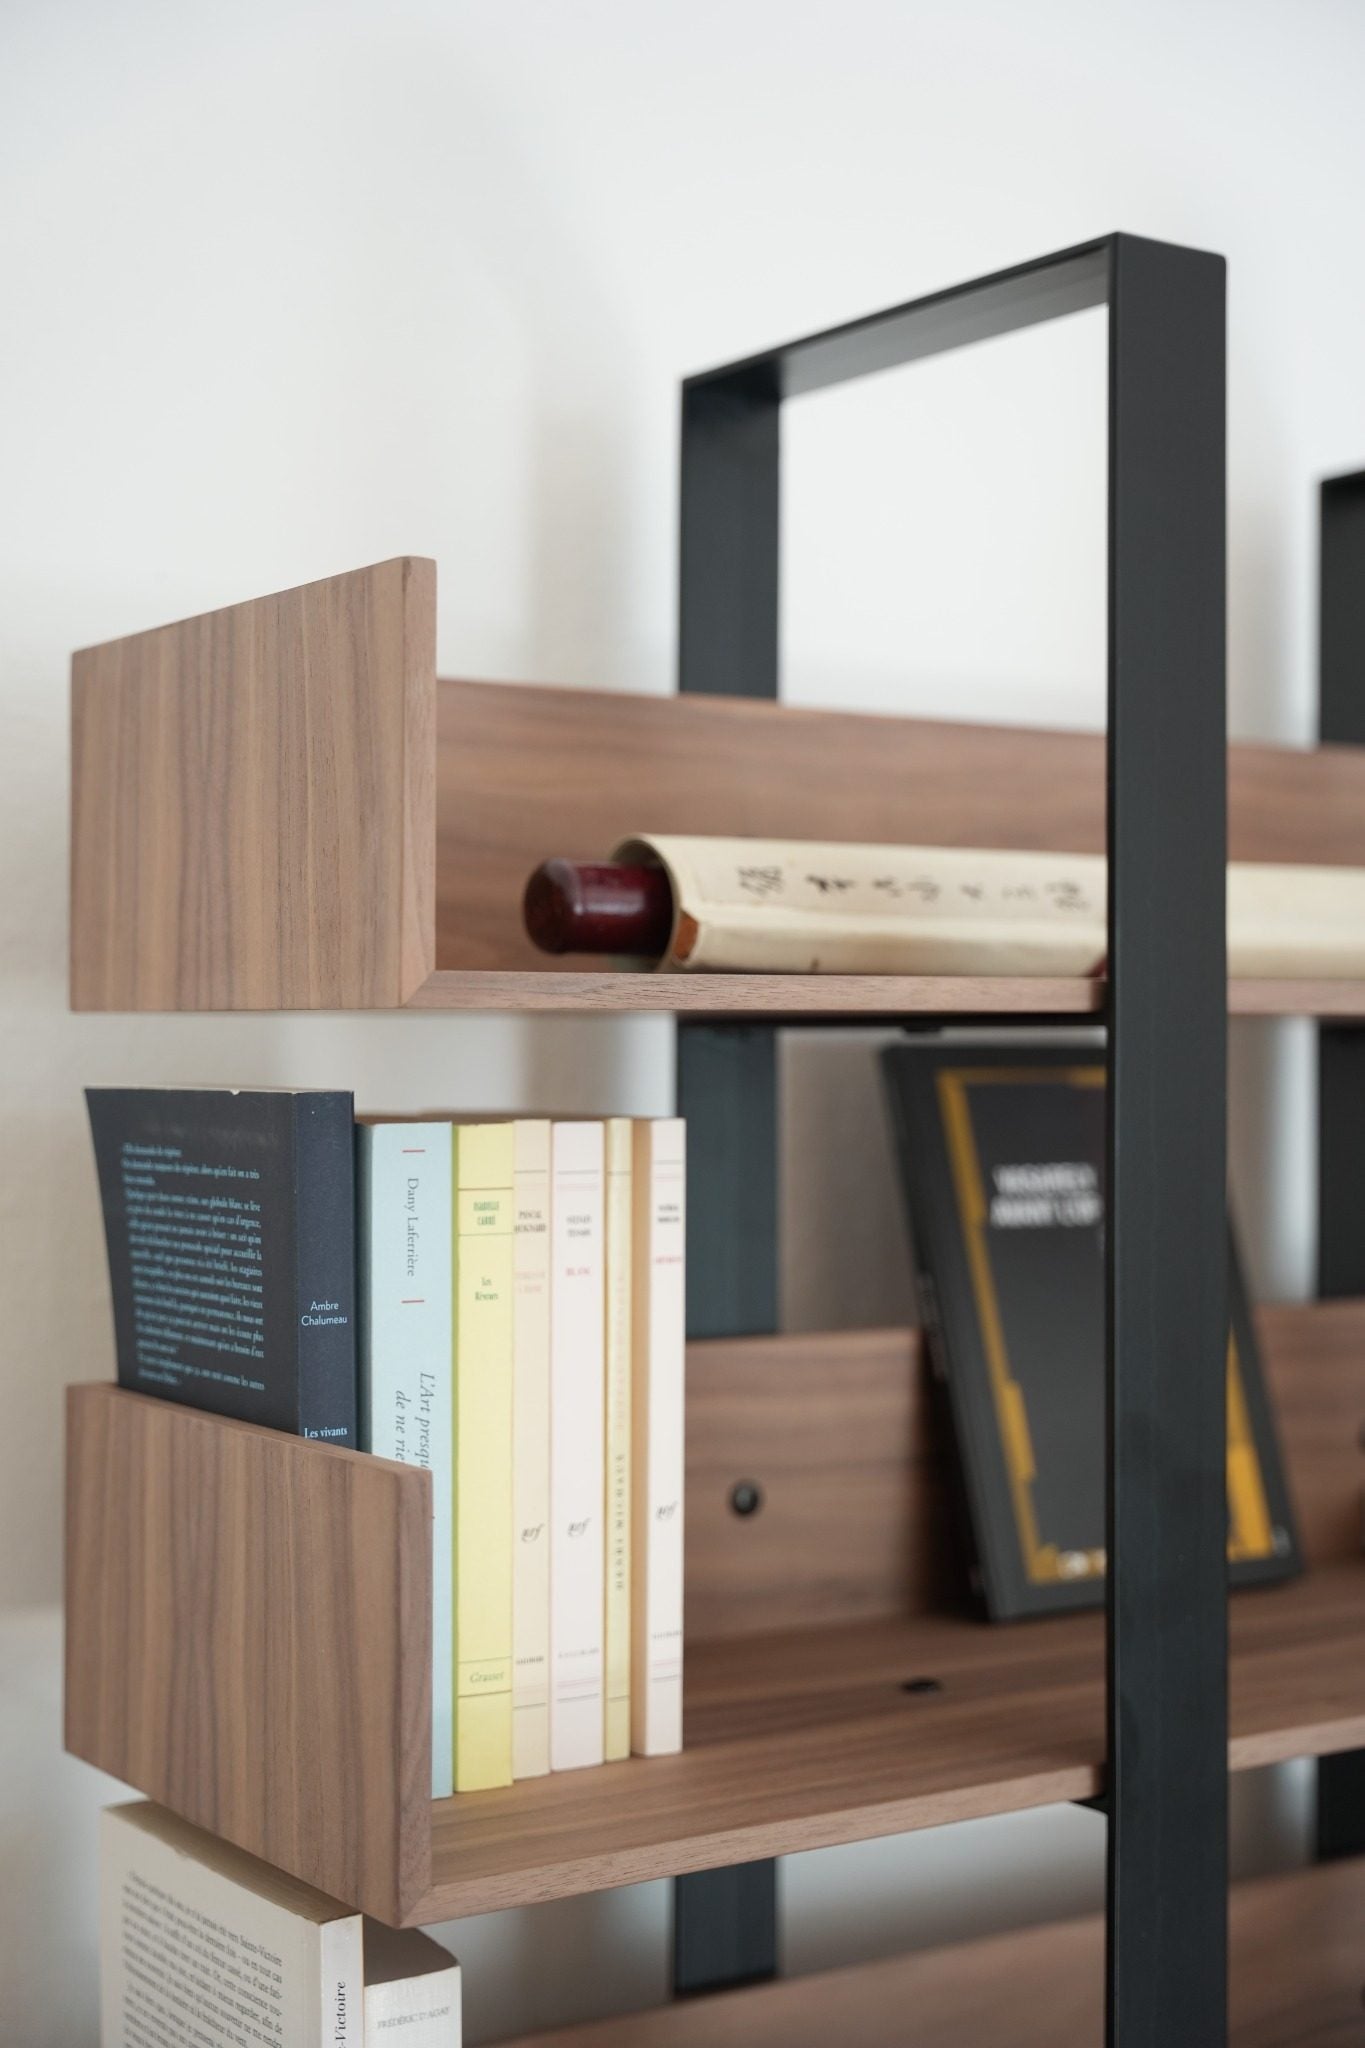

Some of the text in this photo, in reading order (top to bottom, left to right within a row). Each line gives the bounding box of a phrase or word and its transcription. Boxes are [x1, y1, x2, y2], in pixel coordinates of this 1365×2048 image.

[403, 1178, 420, 1278] Dany Laferrière
[310, 1299, 339, 1311] Ambre
[300, 1315, 348, 1327] Chalumeau
[395, 1390, 411, 1409] de
[419, 1372, 435, 1411] L'Art
[395, 1415, 405, 1434] ne
[304, 1427, 348, 1439] Les vivants
[469, 1670, 505, 1684] Grasset
